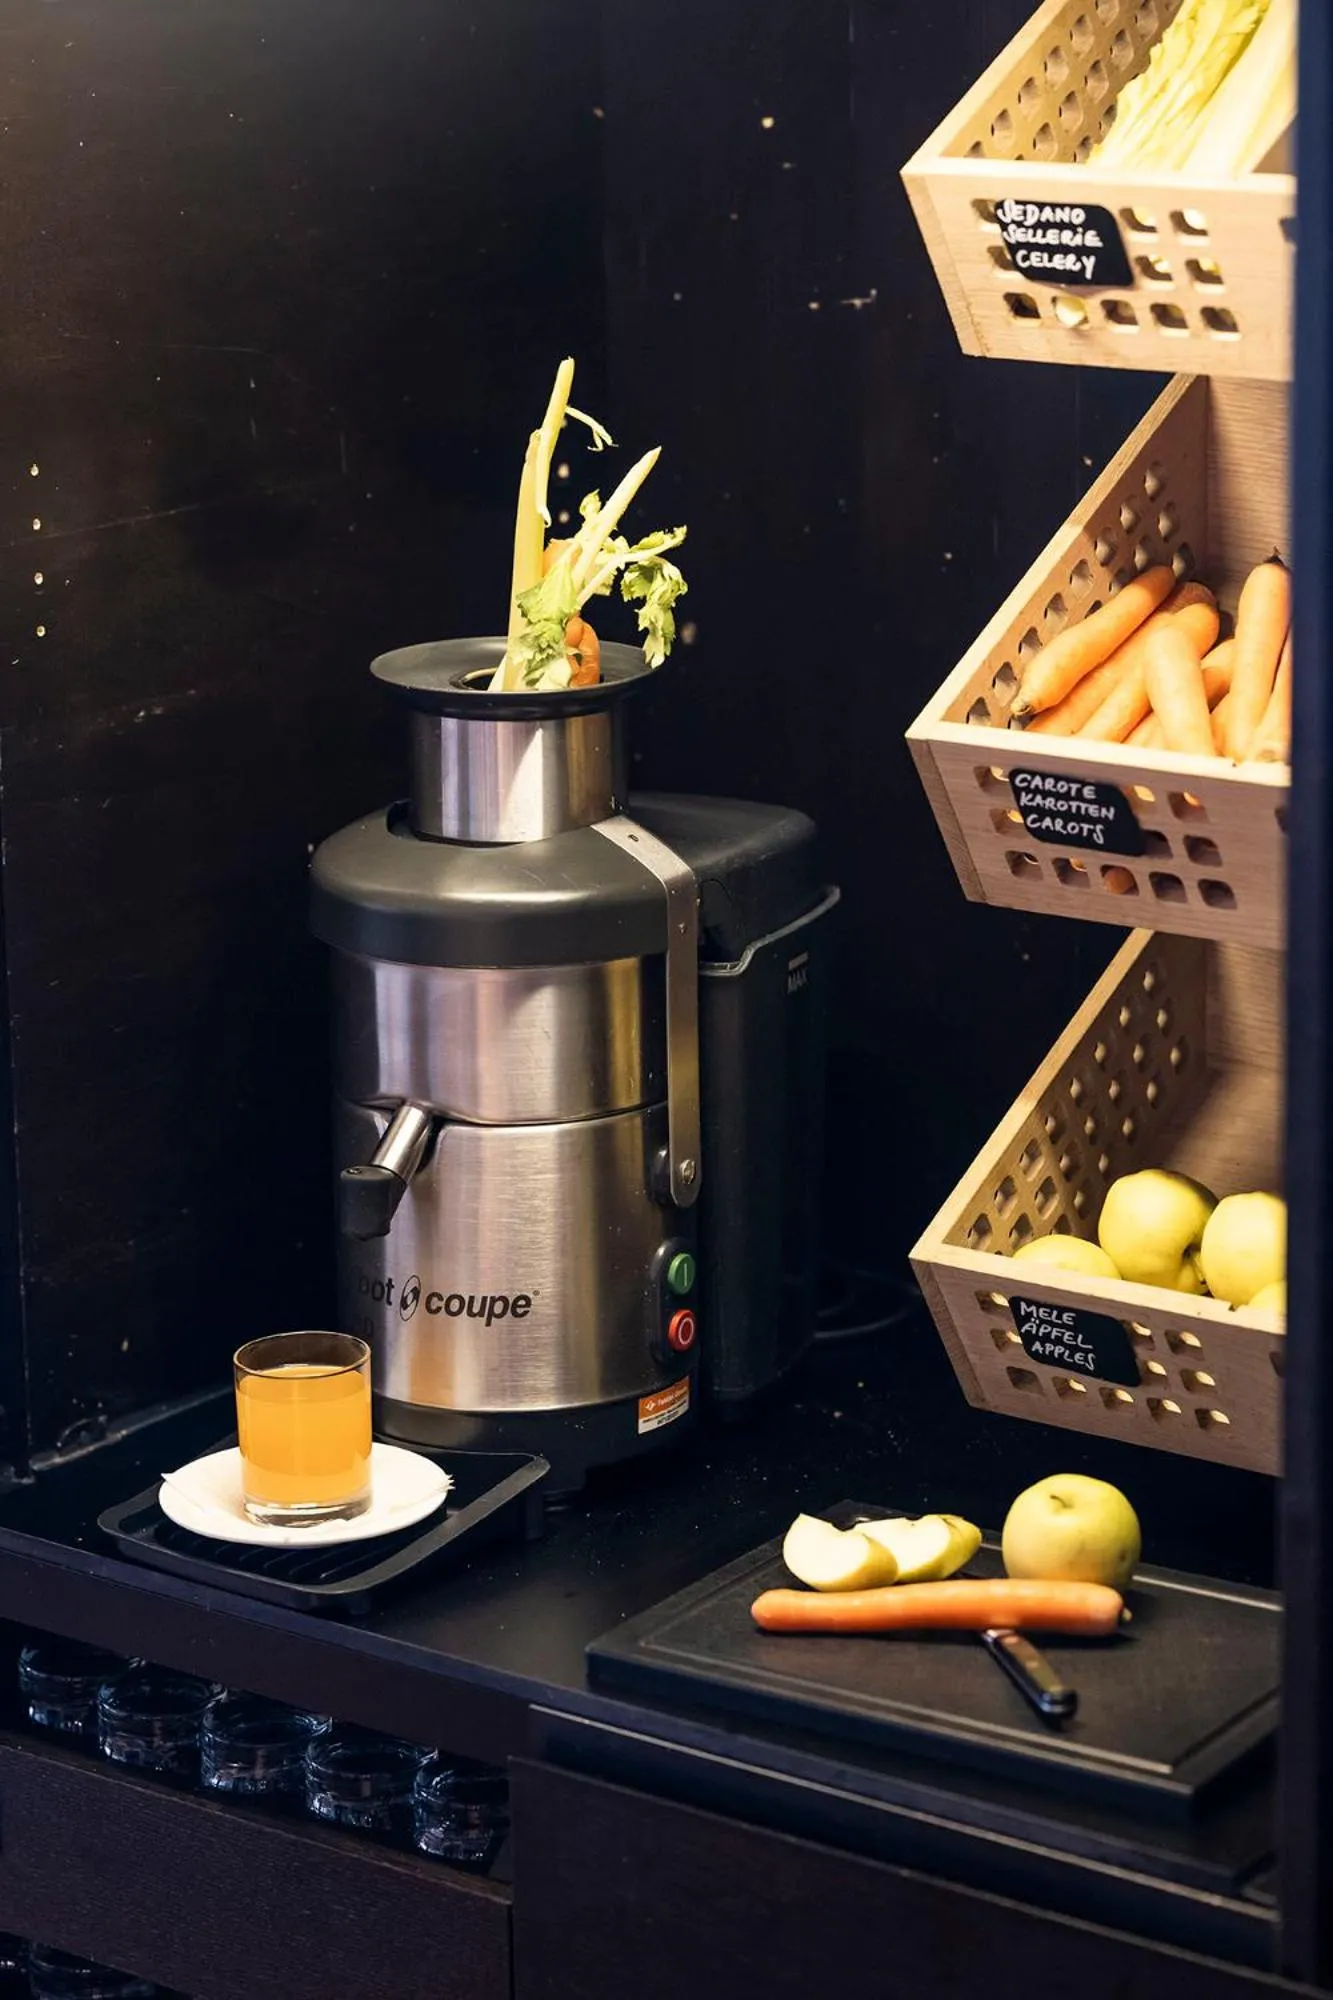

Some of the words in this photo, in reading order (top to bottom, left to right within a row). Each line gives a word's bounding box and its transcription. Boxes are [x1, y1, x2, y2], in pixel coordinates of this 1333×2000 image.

[997, 199, 1086, 226] SEDANO
[1015, 249, 1097, 280] CELERY
[1014, 773, 1097, 799] CAROTE
[1020, 791, 1116, 821] KAROTTEN
[1026, 813, 1105, 845] CAROTS
[425, 1291, 532, 1327] coupe
[1020, 1301, 1077, 1325] MELE
[1021, 1317, 1094, 1349] ÄPFEL
[1032, 1341, 1097, 1372] APPLES
